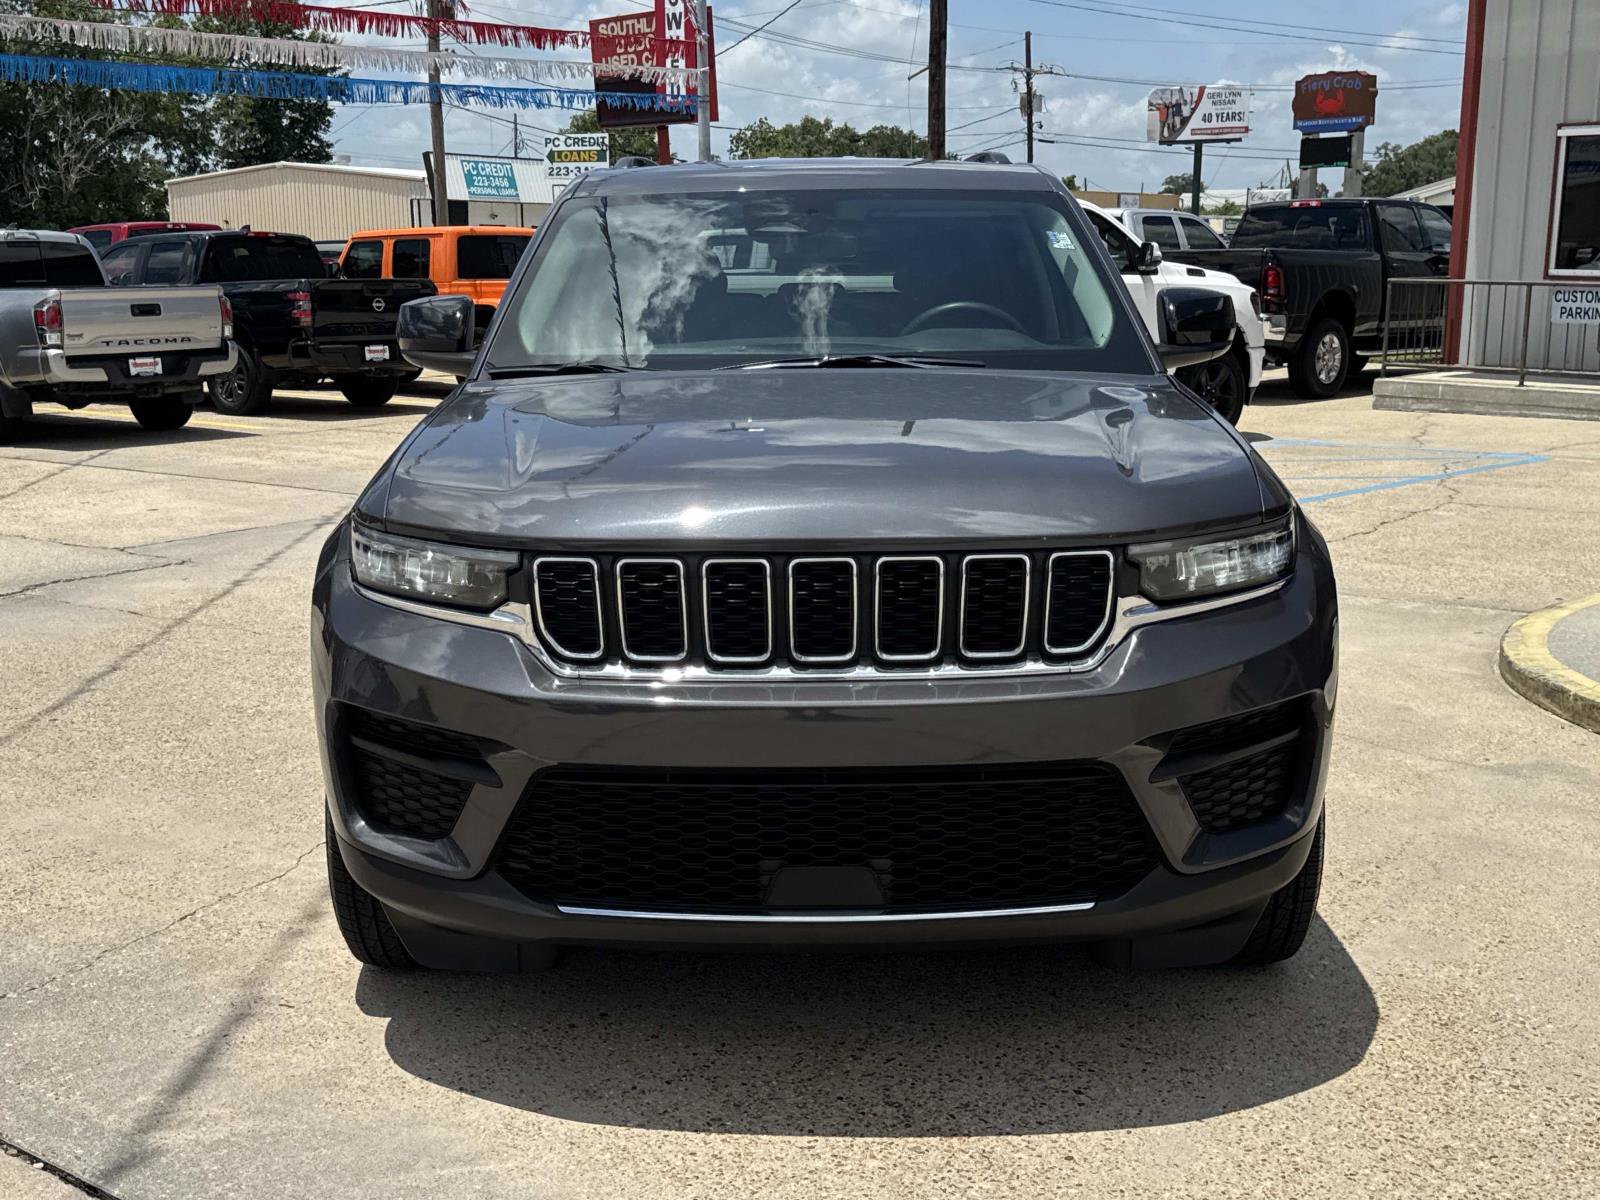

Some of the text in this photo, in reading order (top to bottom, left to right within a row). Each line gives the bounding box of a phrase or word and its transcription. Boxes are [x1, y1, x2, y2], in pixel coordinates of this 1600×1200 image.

[1301, 76, 1362, 94] Fiery Crab
[1224, 91, 1242, 99] LYNN
[1202, 111, 1245, 123] 40 YEARS!
[545, 136, 607, 148] PC CREDIT
[554, 151, 598, 162] LOANS
[463, 162, 511, 177] PC CREDIT
[473, 176, 509, 187] 223-3456
[101, 337, 192, 347] TACOMA
